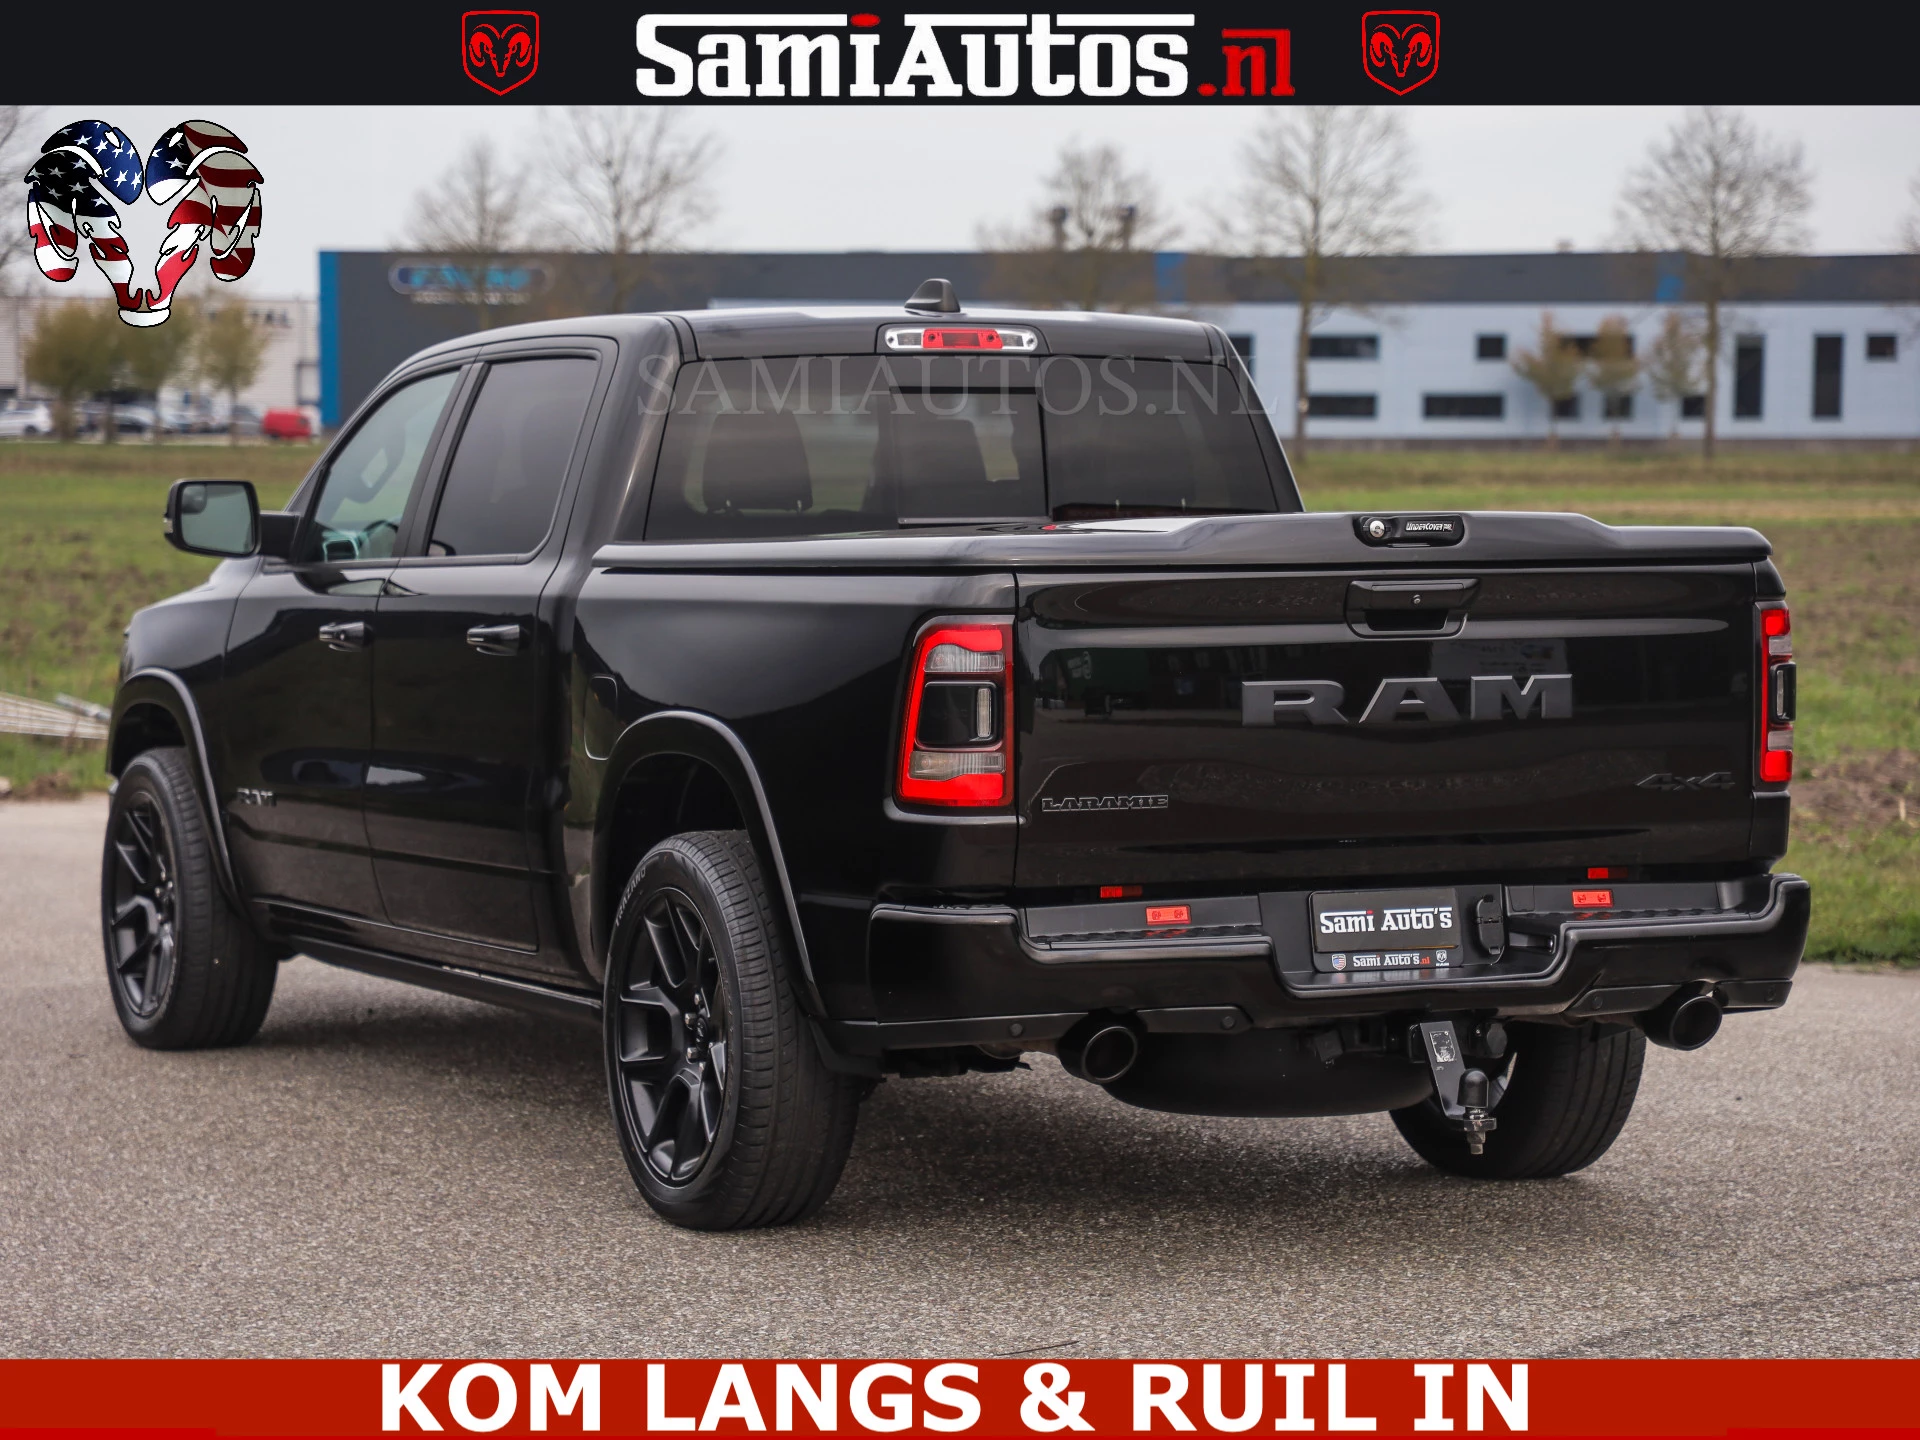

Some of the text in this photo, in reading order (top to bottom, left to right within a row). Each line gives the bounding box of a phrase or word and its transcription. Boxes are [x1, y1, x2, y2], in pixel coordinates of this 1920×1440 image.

[1242, 674, 1573, 727] RAM
[1634, 771, 1736, 791] 4x4
[1041, 794, 1169, 812] LARAMIE
[1319, 906, 1453, 934] Sami Auto's
[1352, 954, 1381, 967] Sami
